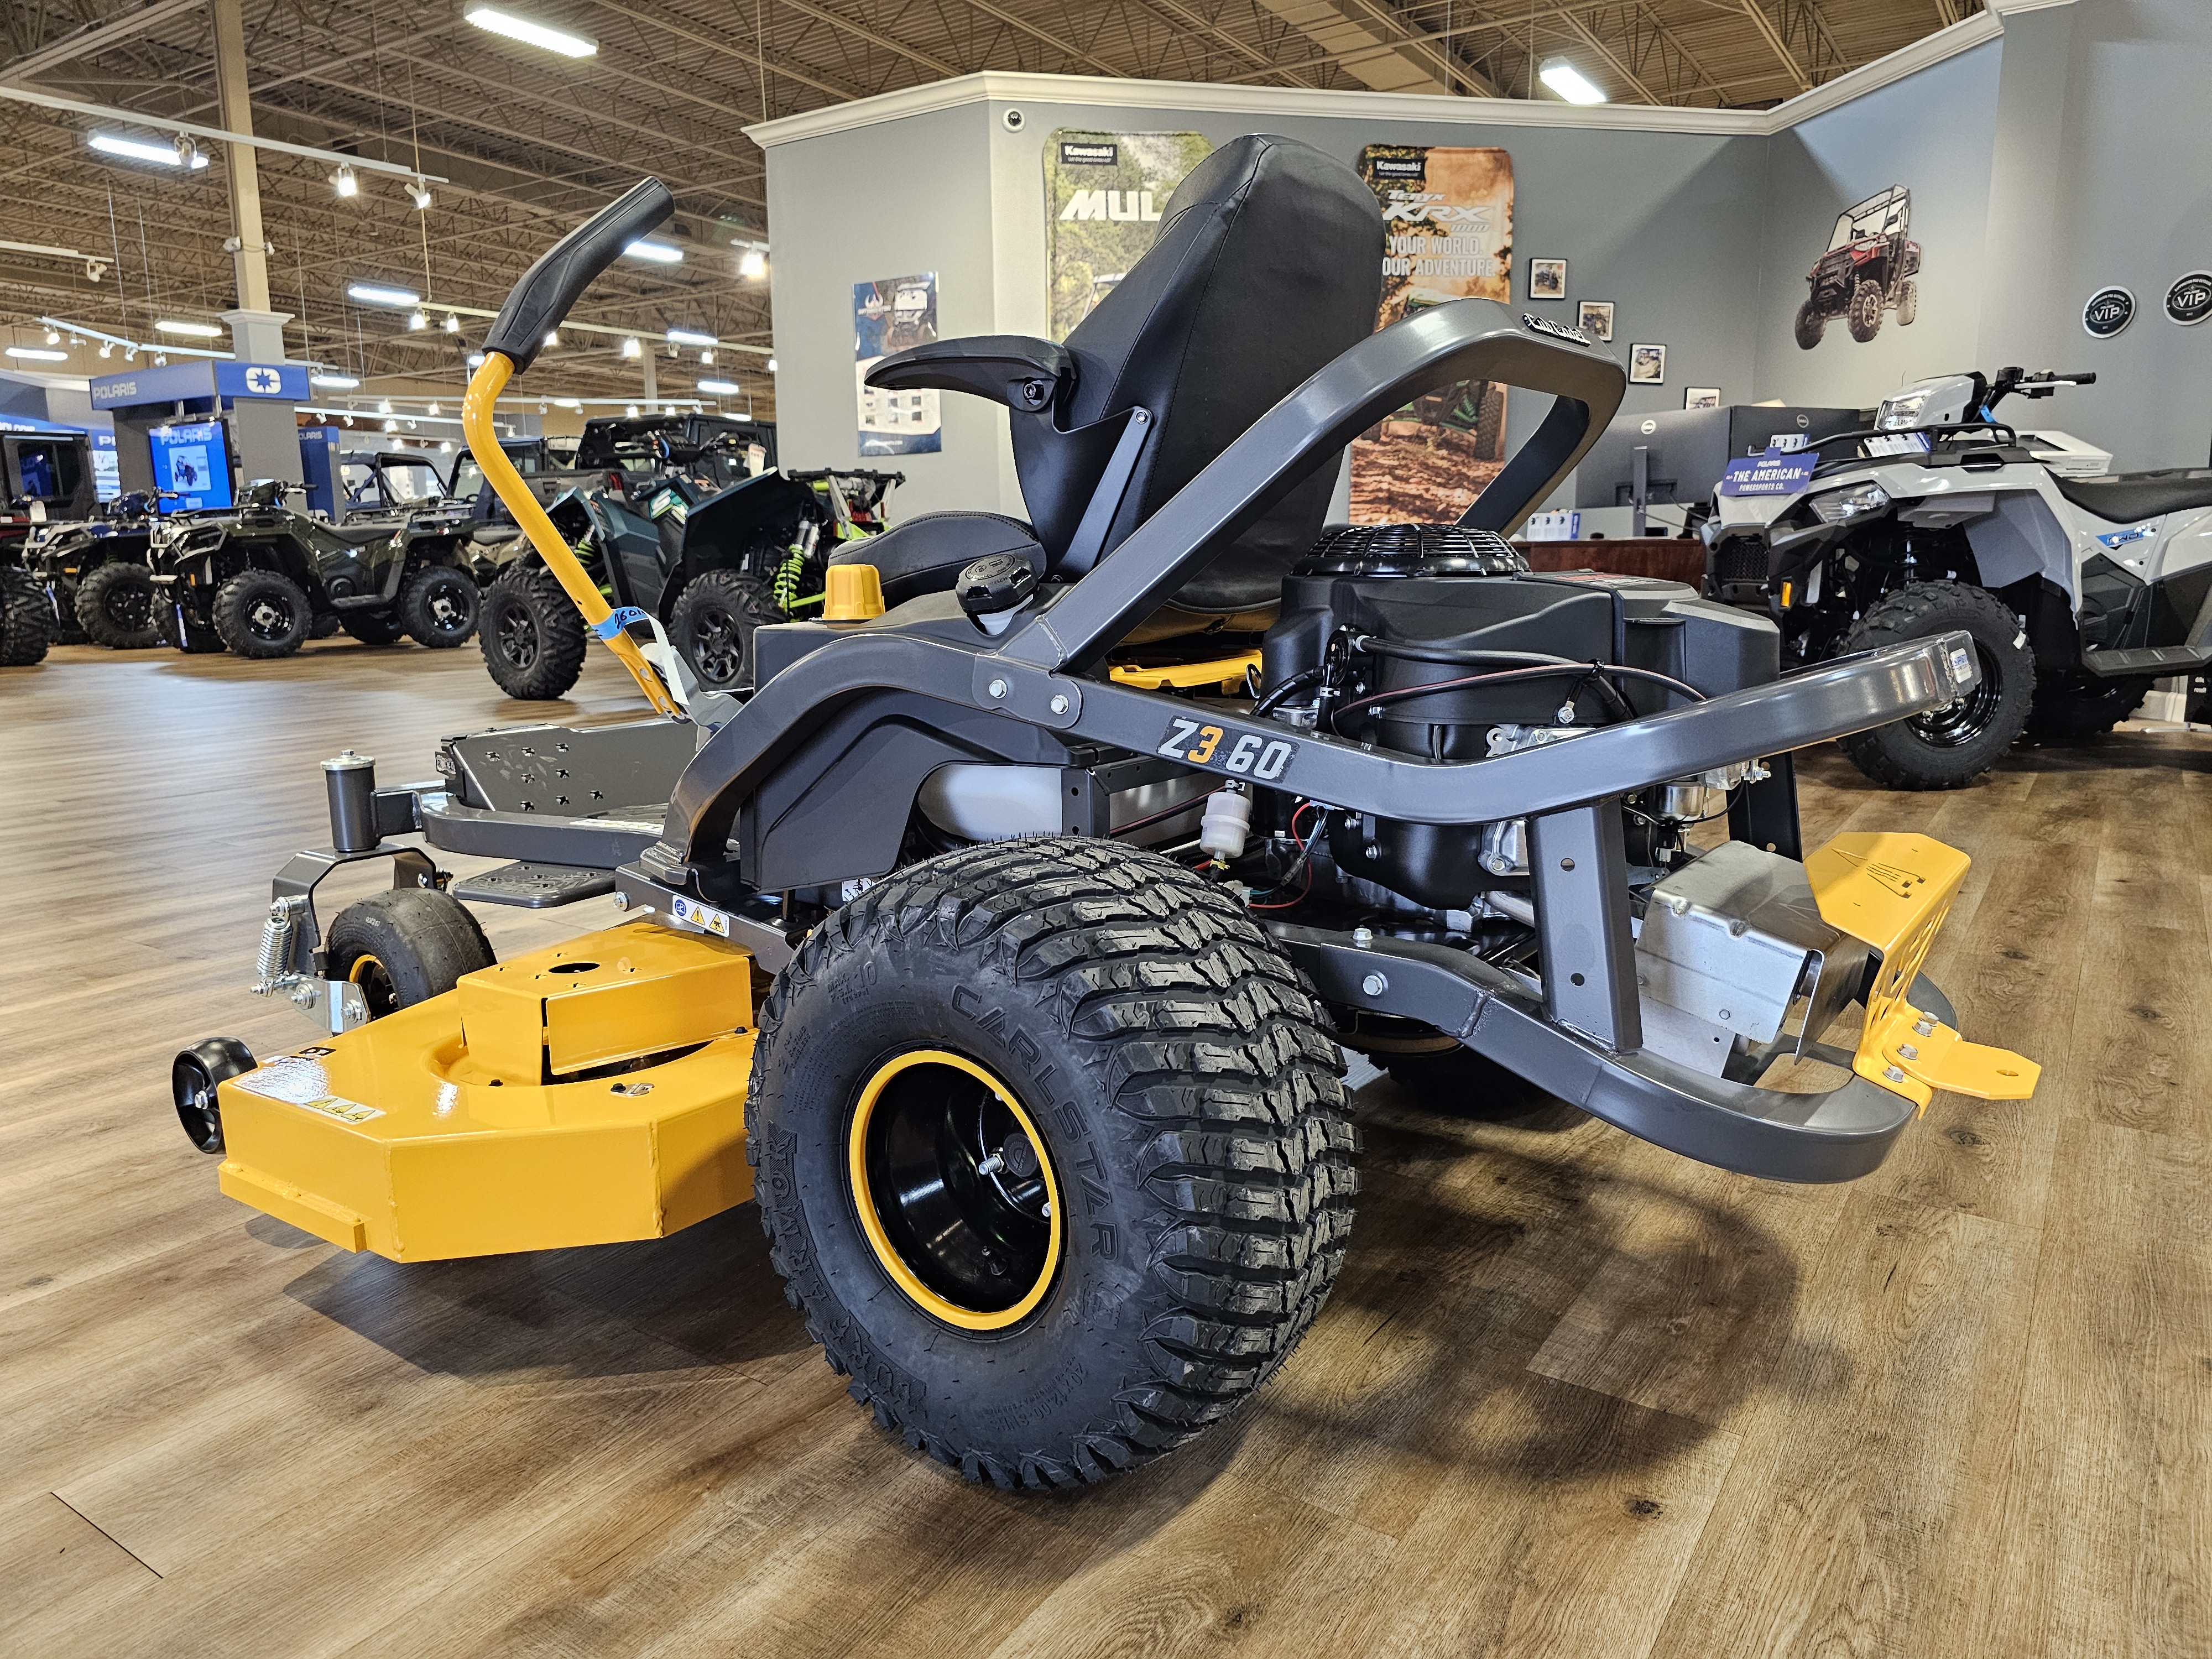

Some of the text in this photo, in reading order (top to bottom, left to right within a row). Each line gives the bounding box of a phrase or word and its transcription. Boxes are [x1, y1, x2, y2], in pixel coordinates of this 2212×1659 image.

[1065, 145, 1114, 157] Kawasaki
[1376, 161, 1422, 171] Kawasaki
[1059, 190, 1161, 221] MUL
[1383, 201, 1493, 222] KRX
[1451, 224, 1490, 233] 1000
[1389, 236, 1483, 255] YOUR WORLD.
[1383, 257, 1496, 277] OUR ADVENTURE.
[2177, 292, 2206, 307] VIP
[2095, 307, 2120, 321] VIP
[93, 382, 137, 400] POLARIS
[160, 426, 212, 446] POLARIS
[299, 431, 322, 440] OLARIS
[1733, 467, 1802, 482] THE AMERICAN
[1739, 482, 1785, 492] POWERSPORTS CO.
[951, 983, 1119, 1261] CARLSTAR
